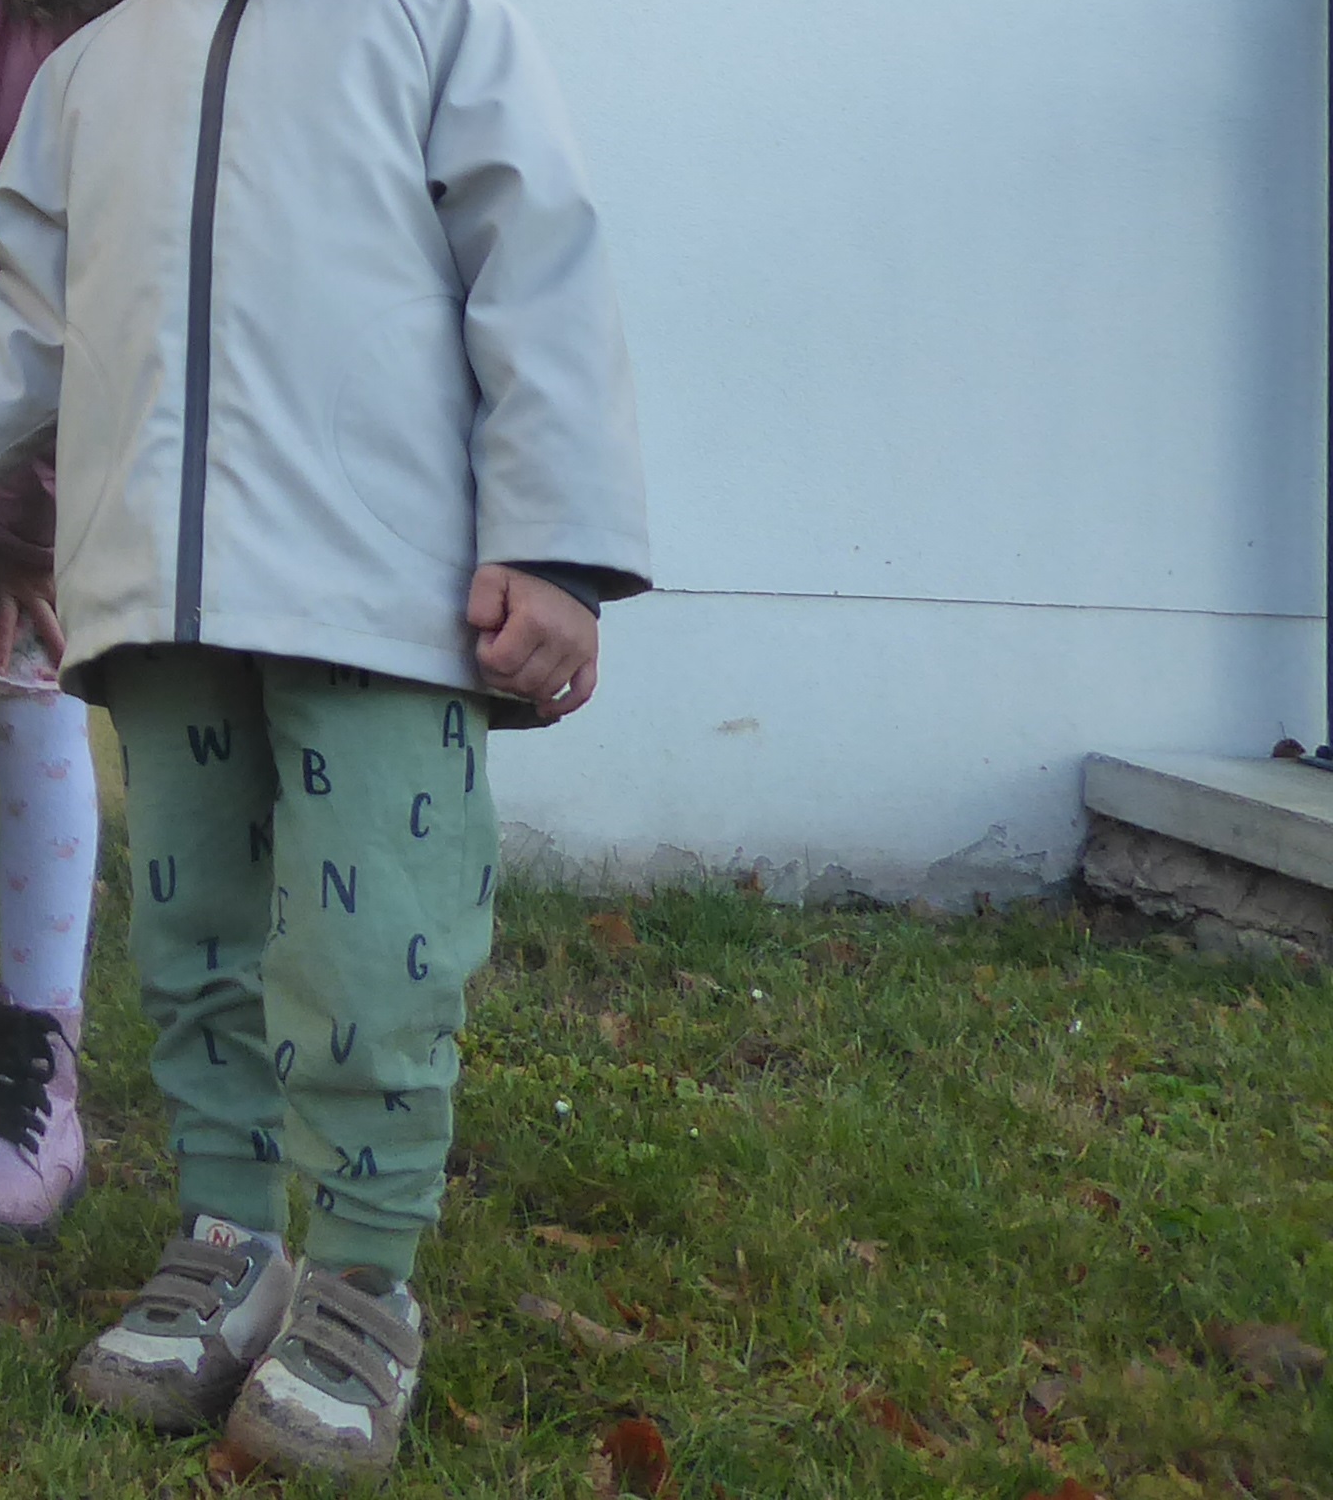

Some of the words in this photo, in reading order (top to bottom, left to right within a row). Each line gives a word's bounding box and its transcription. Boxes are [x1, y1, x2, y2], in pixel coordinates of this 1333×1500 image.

[187, 719, 231, 766] W
[443, 700, 465, 749] A
[302, 748, 332, 795] B
[410, 792, 431, 838] C
[149, 854, 176, 902] U
[321, 860, 356, 913] N
[407, 933, 428, 981] G
